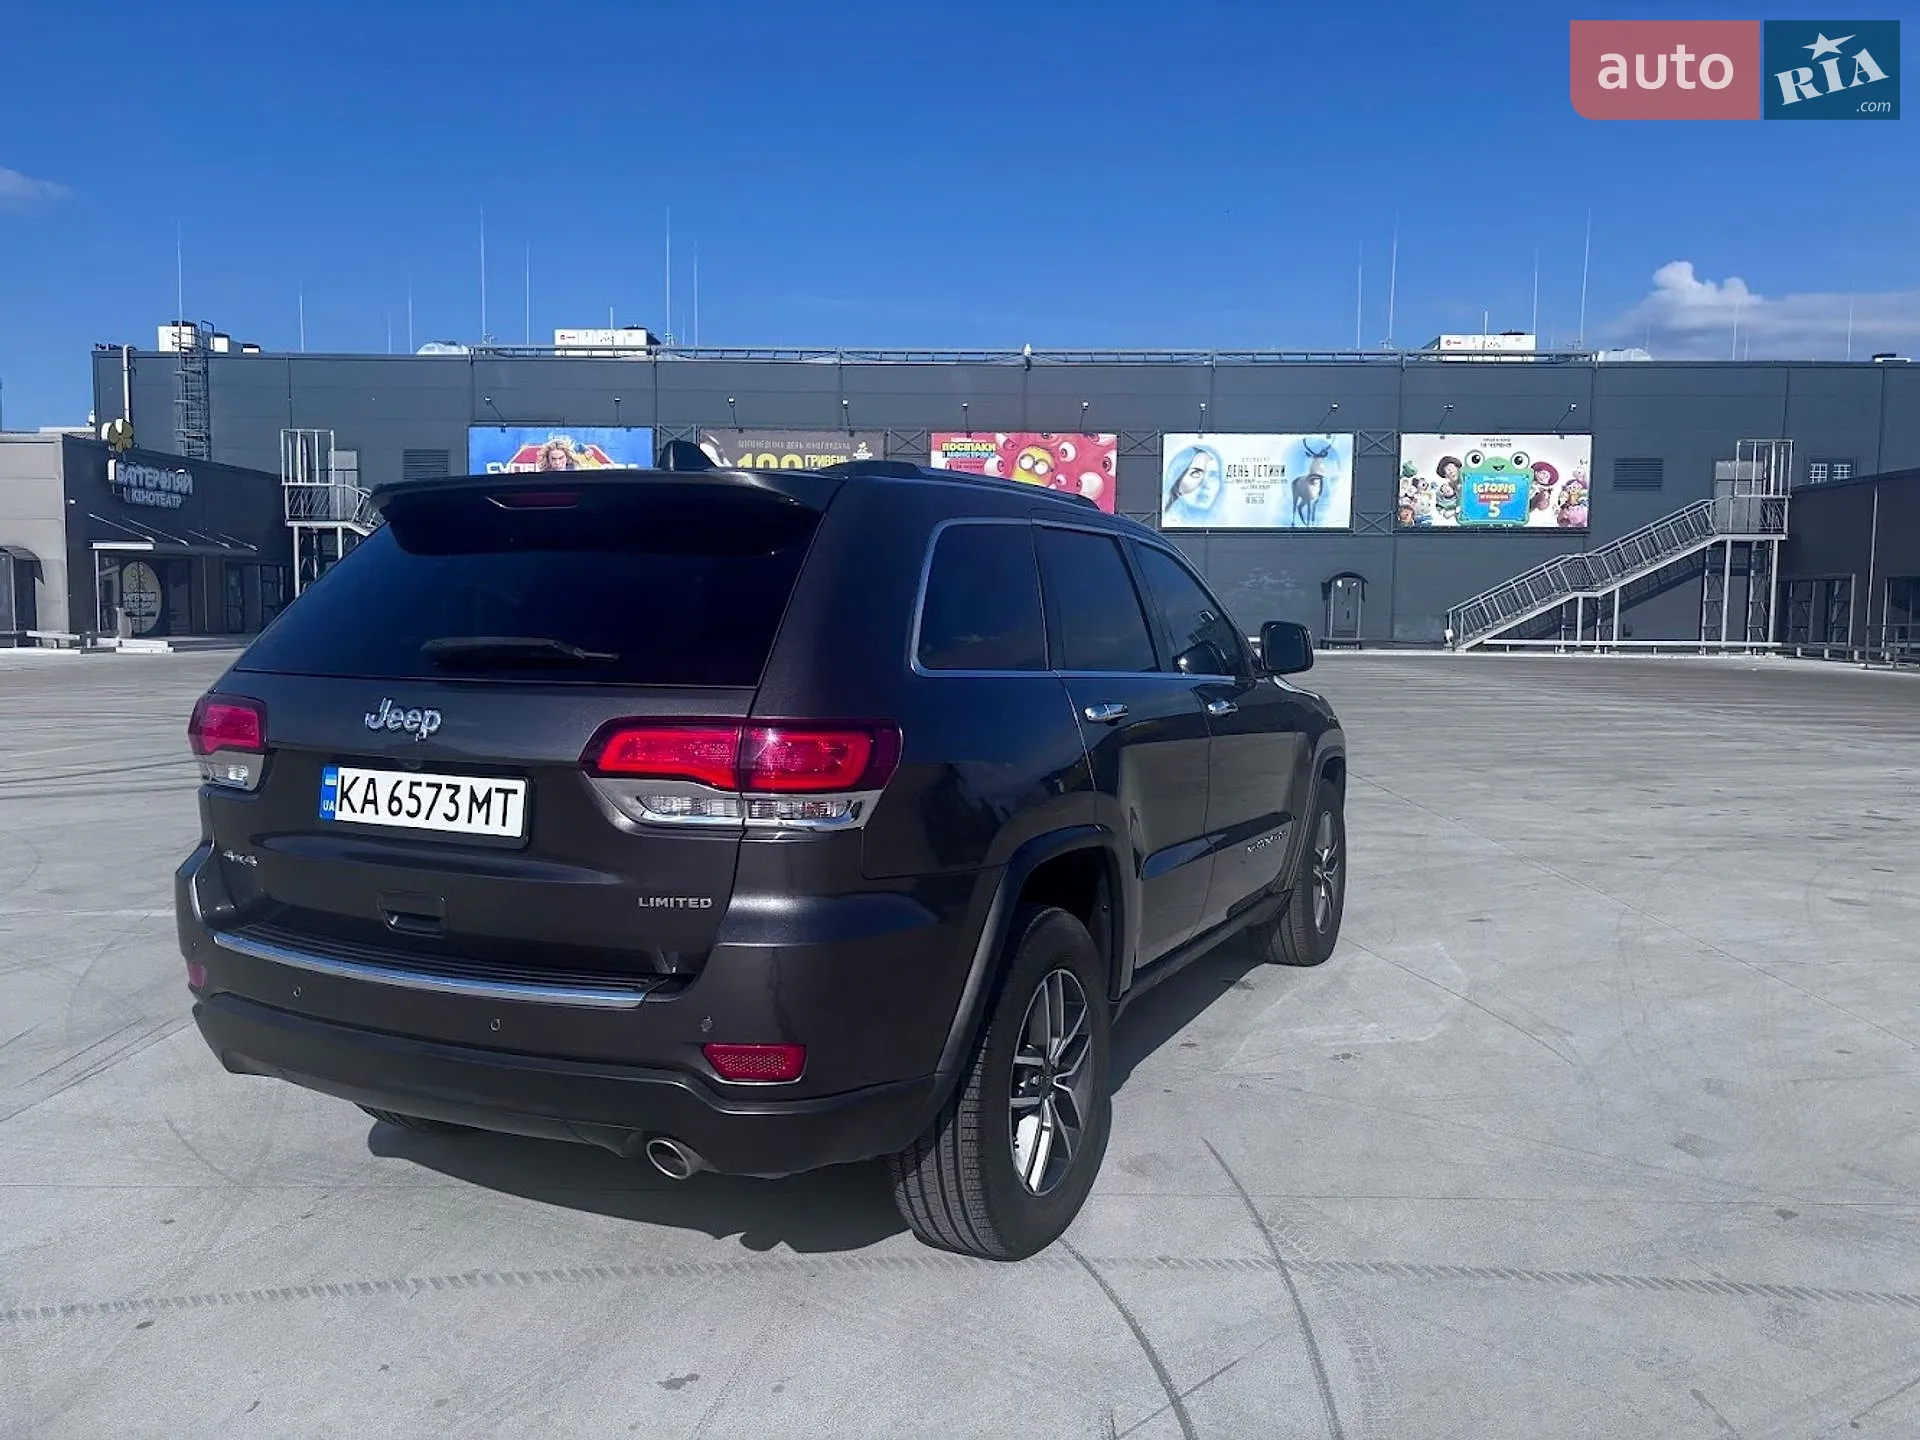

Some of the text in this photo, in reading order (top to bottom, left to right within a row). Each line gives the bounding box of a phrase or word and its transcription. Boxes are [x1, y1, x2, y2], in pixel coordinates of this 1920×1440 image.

[942, 442, 997, 452] ПОСІПАКИ
[1226, 464, 1249, 479] ДЕНЬ
[1473, 482, 1517, 494] ІСТОРІЯ
[1488, 501, 1501, 518] 5
[365, 697, 442, 742] Jeep
[387, 780, 461, 822] 6573
[638, 897, 713, 909] LIMITED
